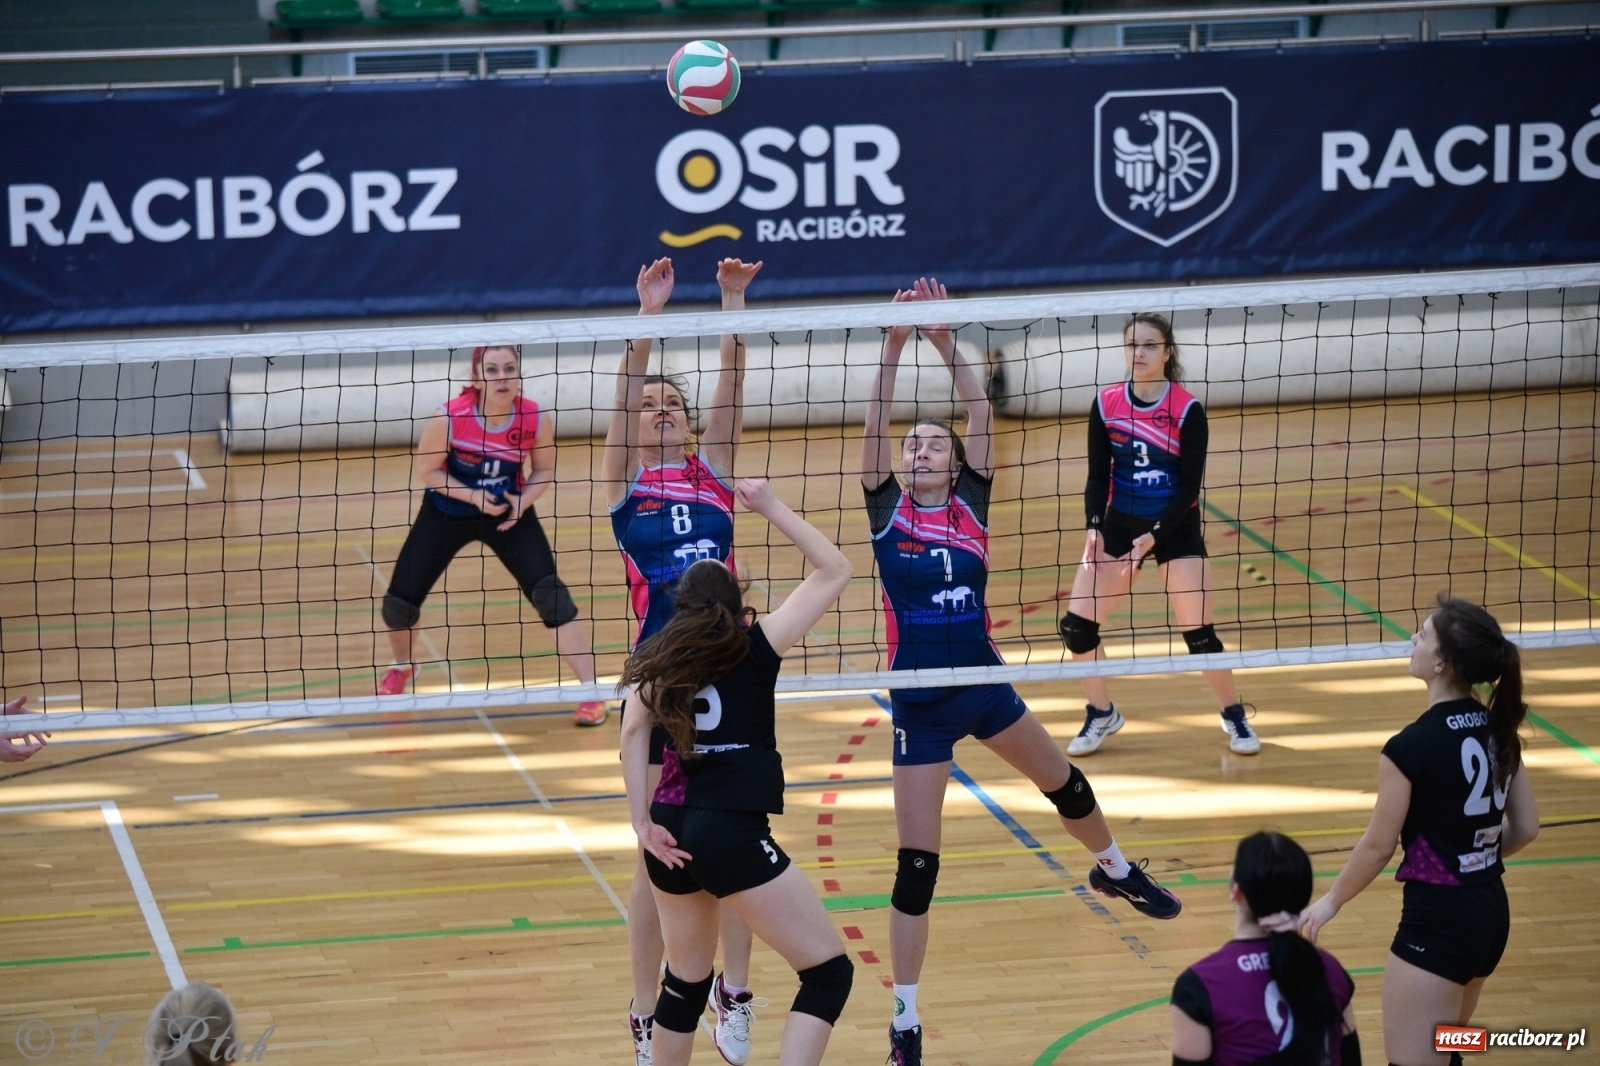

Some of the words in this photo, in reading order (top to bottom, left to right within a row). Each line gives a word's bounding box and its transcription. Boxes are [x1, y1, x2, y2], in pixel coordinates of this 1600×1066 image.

[8, 149, 461, 247] RACIBÓRZ
[756, 208, 906, 243] RACIBÓRZ
[1132, 441, 1150, 468] 3
[670, 503, 693, 535] 8
[930, 547, 953, 583] 7
[1446, 711, 1489, 730] GROBO
[760, 839, 779, 864] 5
[1237, 951, 1272, 972] GRE
